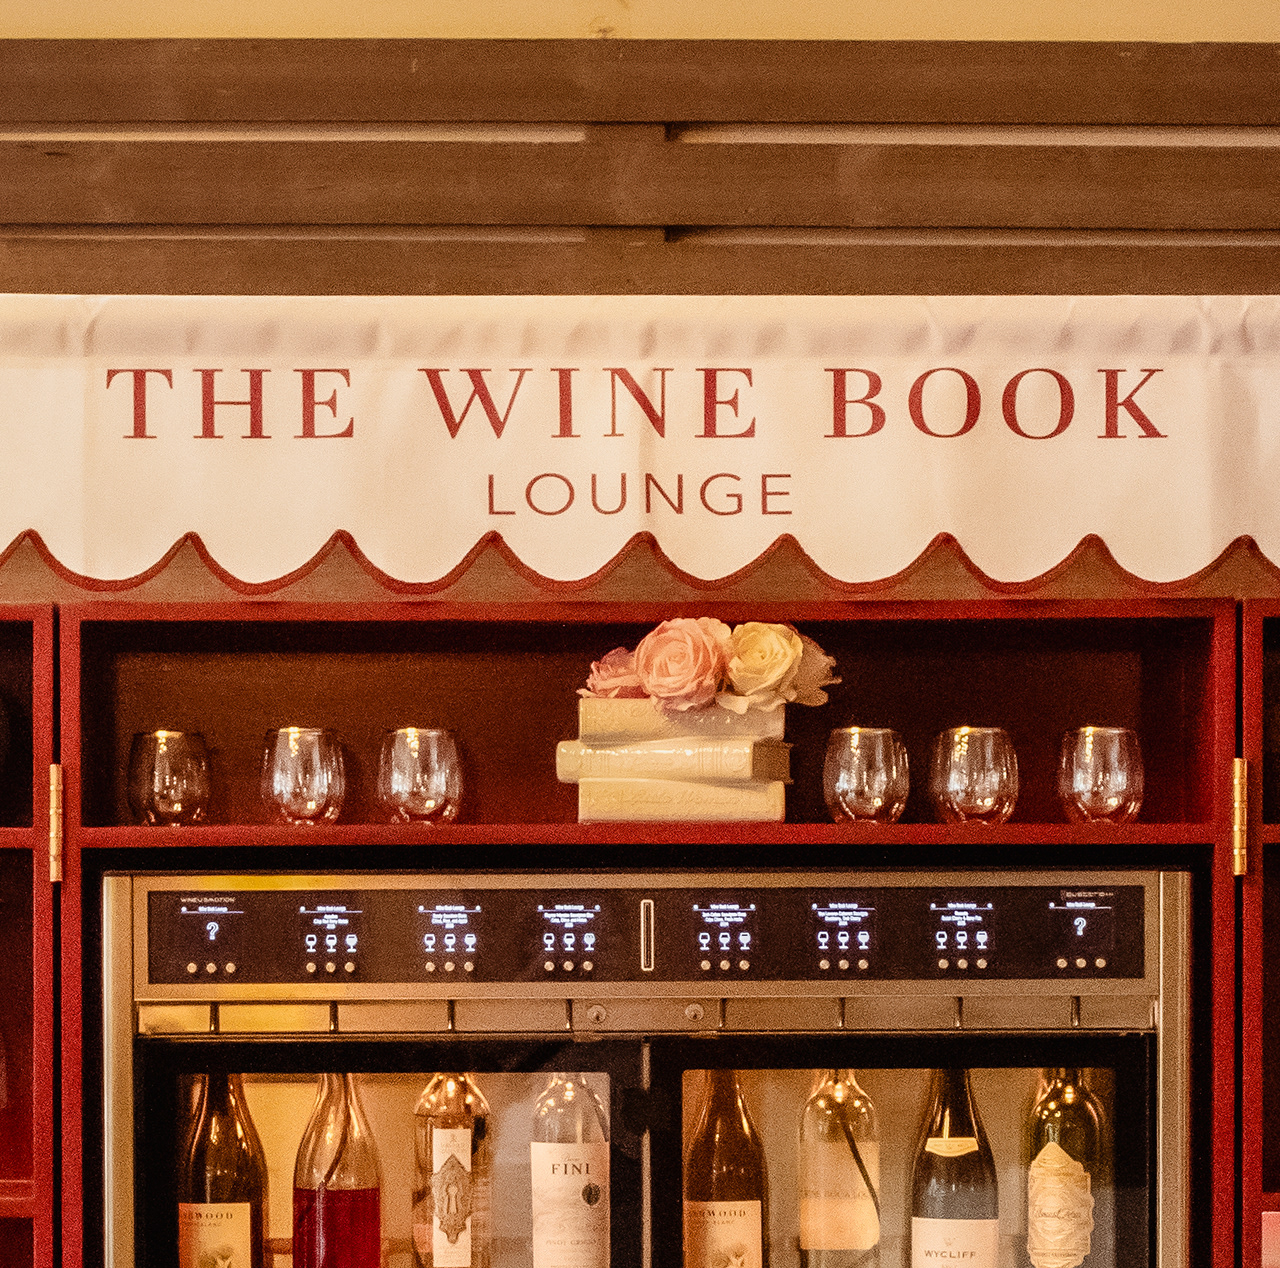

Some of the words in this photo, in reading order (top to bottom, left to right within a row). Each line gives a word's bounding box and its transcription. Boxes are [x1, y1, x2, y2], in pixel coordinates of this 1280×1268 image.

[106, 367, 355, 440] THE
[417, 367, 758, 440] WINE
[823, 366, 1168, 441] BOOK
[487, 471, 793, 518] LOUNGE
[551, 1163, 591, 1176] FINI
[924, 1249, 977, 1259] WYCLIFF
